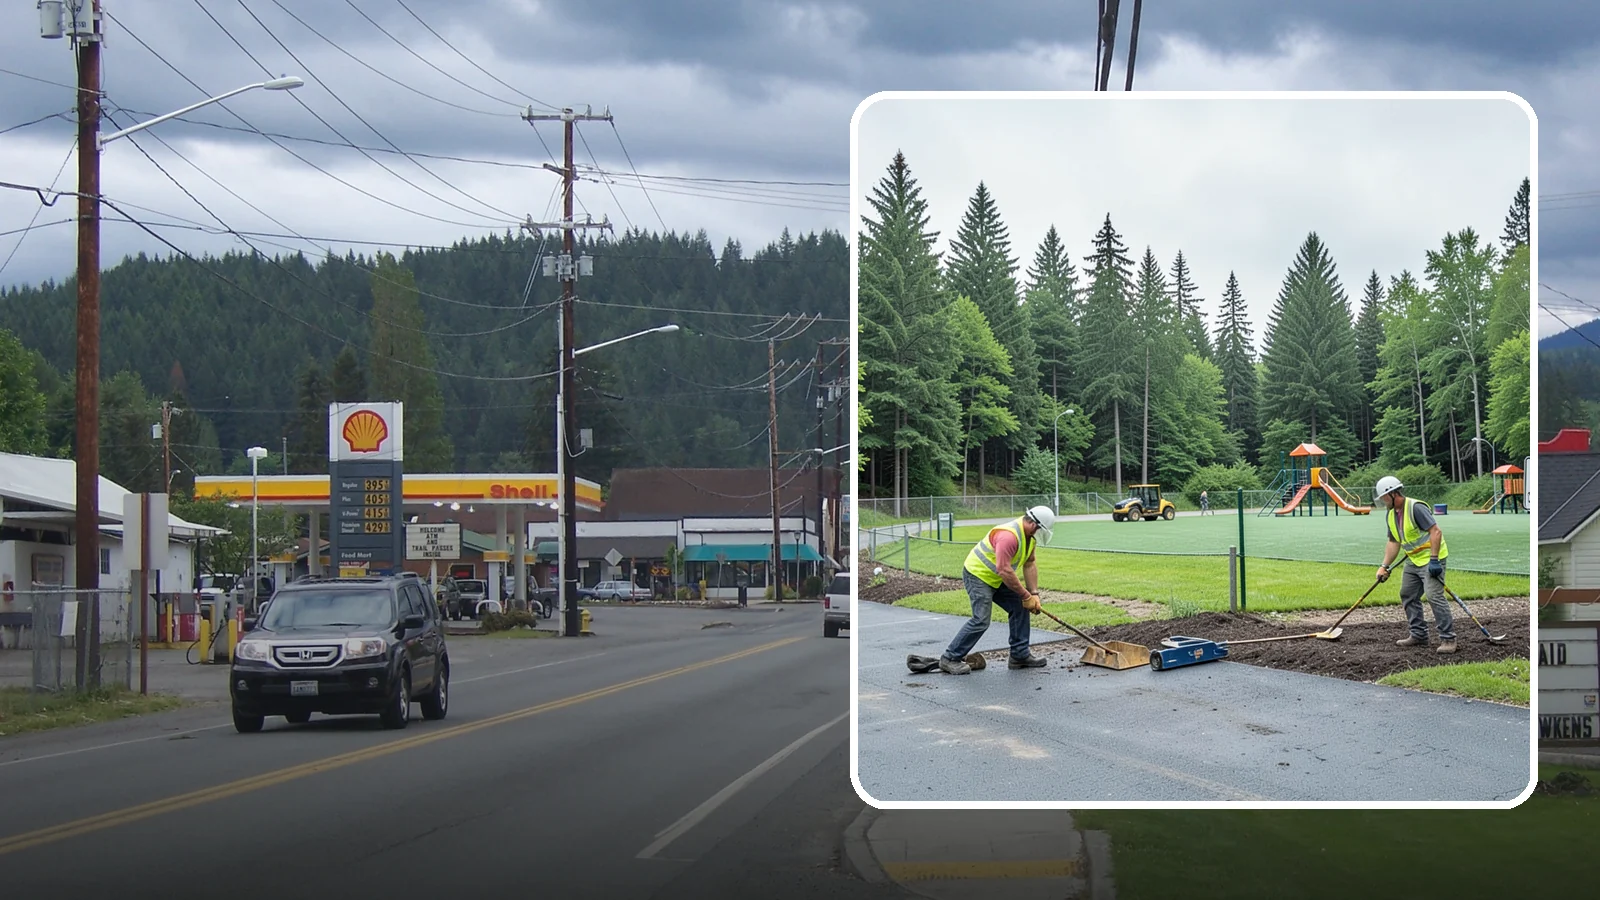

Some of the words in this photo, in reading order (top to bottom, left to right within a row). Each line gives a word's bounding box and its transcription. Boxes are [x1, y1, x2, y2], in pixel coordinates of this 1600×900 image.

[366, 480, 383, 490] 395
[490, 484, 547, 499] Shell
[365, 494, 383, 504] 405
[365, 508, 383, 518] 415
[366, 522, 383, 532] 429
